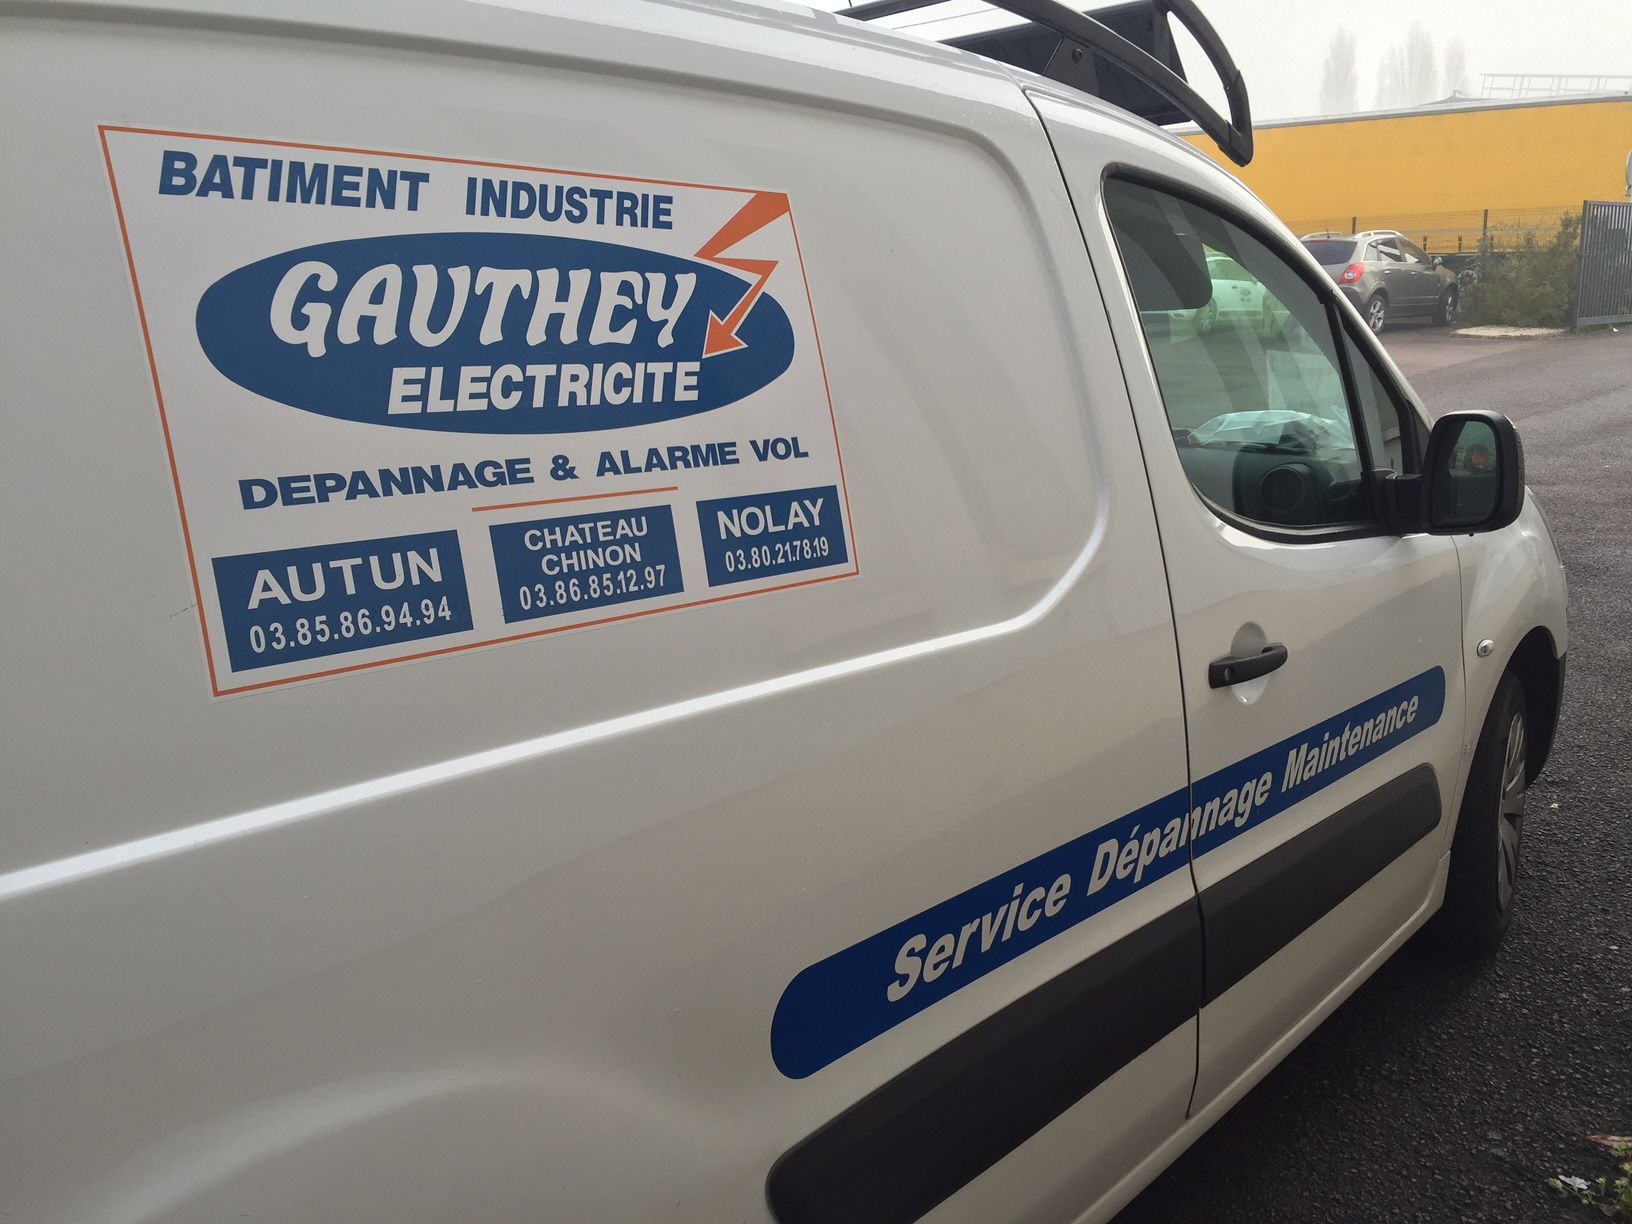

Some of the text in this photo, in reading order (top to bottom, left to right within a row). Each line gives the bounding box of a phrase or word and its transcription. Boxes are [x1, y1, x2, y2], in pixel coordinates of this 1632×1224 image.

[158, 150, 673, 230] BATIMENT INDUSTRIE
[270, 260, 697, 358] GAUTHEY
[387, 361, 700, 415] ELECTRICITE
[238, 436, 809, 510] DEPANNAGE & ALARME VOL
[523, 516, 649, 552] CHATEAU
[717, 498, 824, 539] NOLAY
[247, 548, 443, 610] AUTUN
[541, 542, 642, 577] CHINON
[724, 536, 829, 573] 03.80.21.78.19
[518, 564, 667, 611] 03.86.85.12.97
[248, 595, 452, 654] 03.85.86.94.94
[886, 694, 1419, 1003] Service Dépannage Maintenance
